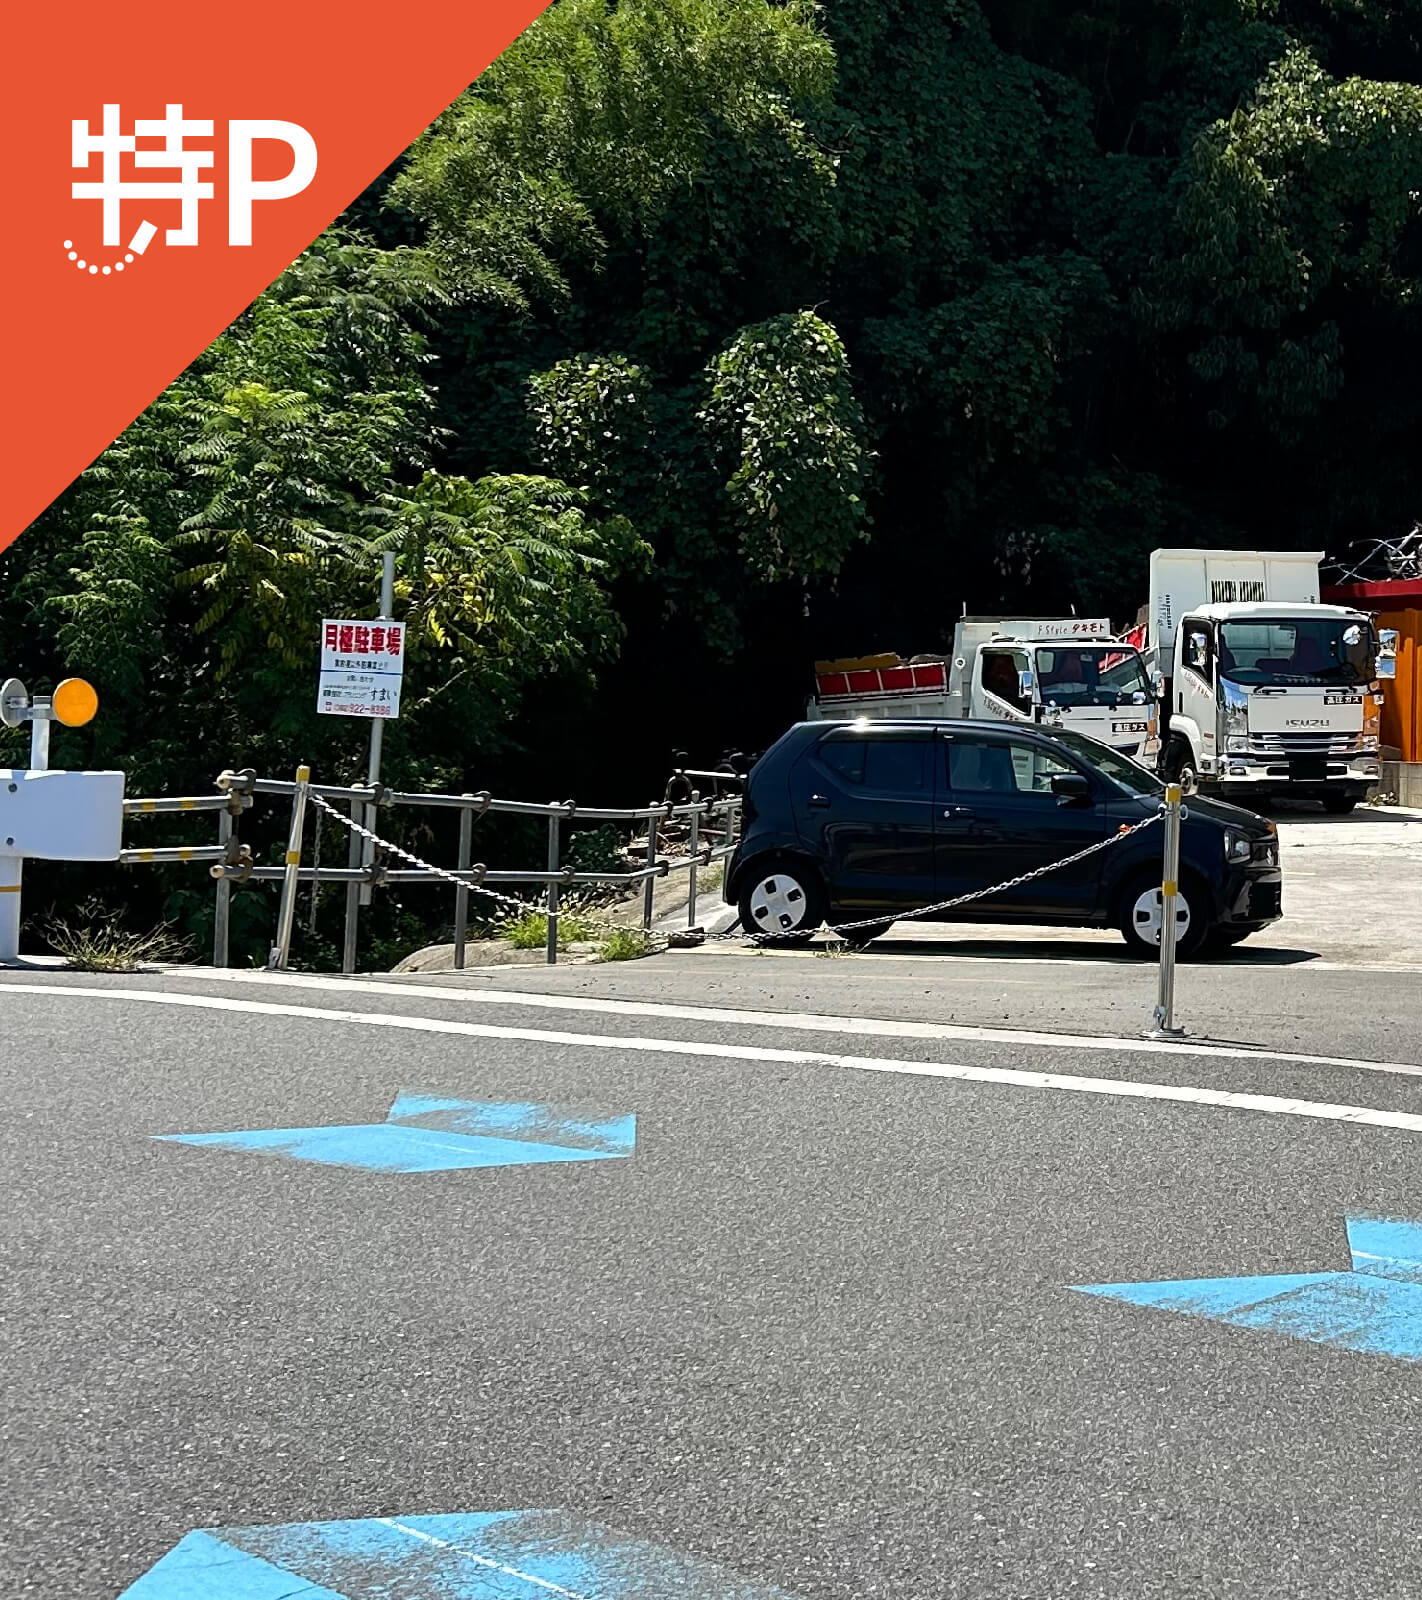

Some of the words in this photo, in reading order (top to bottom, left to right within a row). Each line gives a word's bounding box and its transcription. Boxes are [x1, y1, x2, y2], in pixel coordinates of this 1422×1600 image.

[325, 624, 401, 656] 月極駐車場
[1285, 719, 1330, 728] ISUZU
